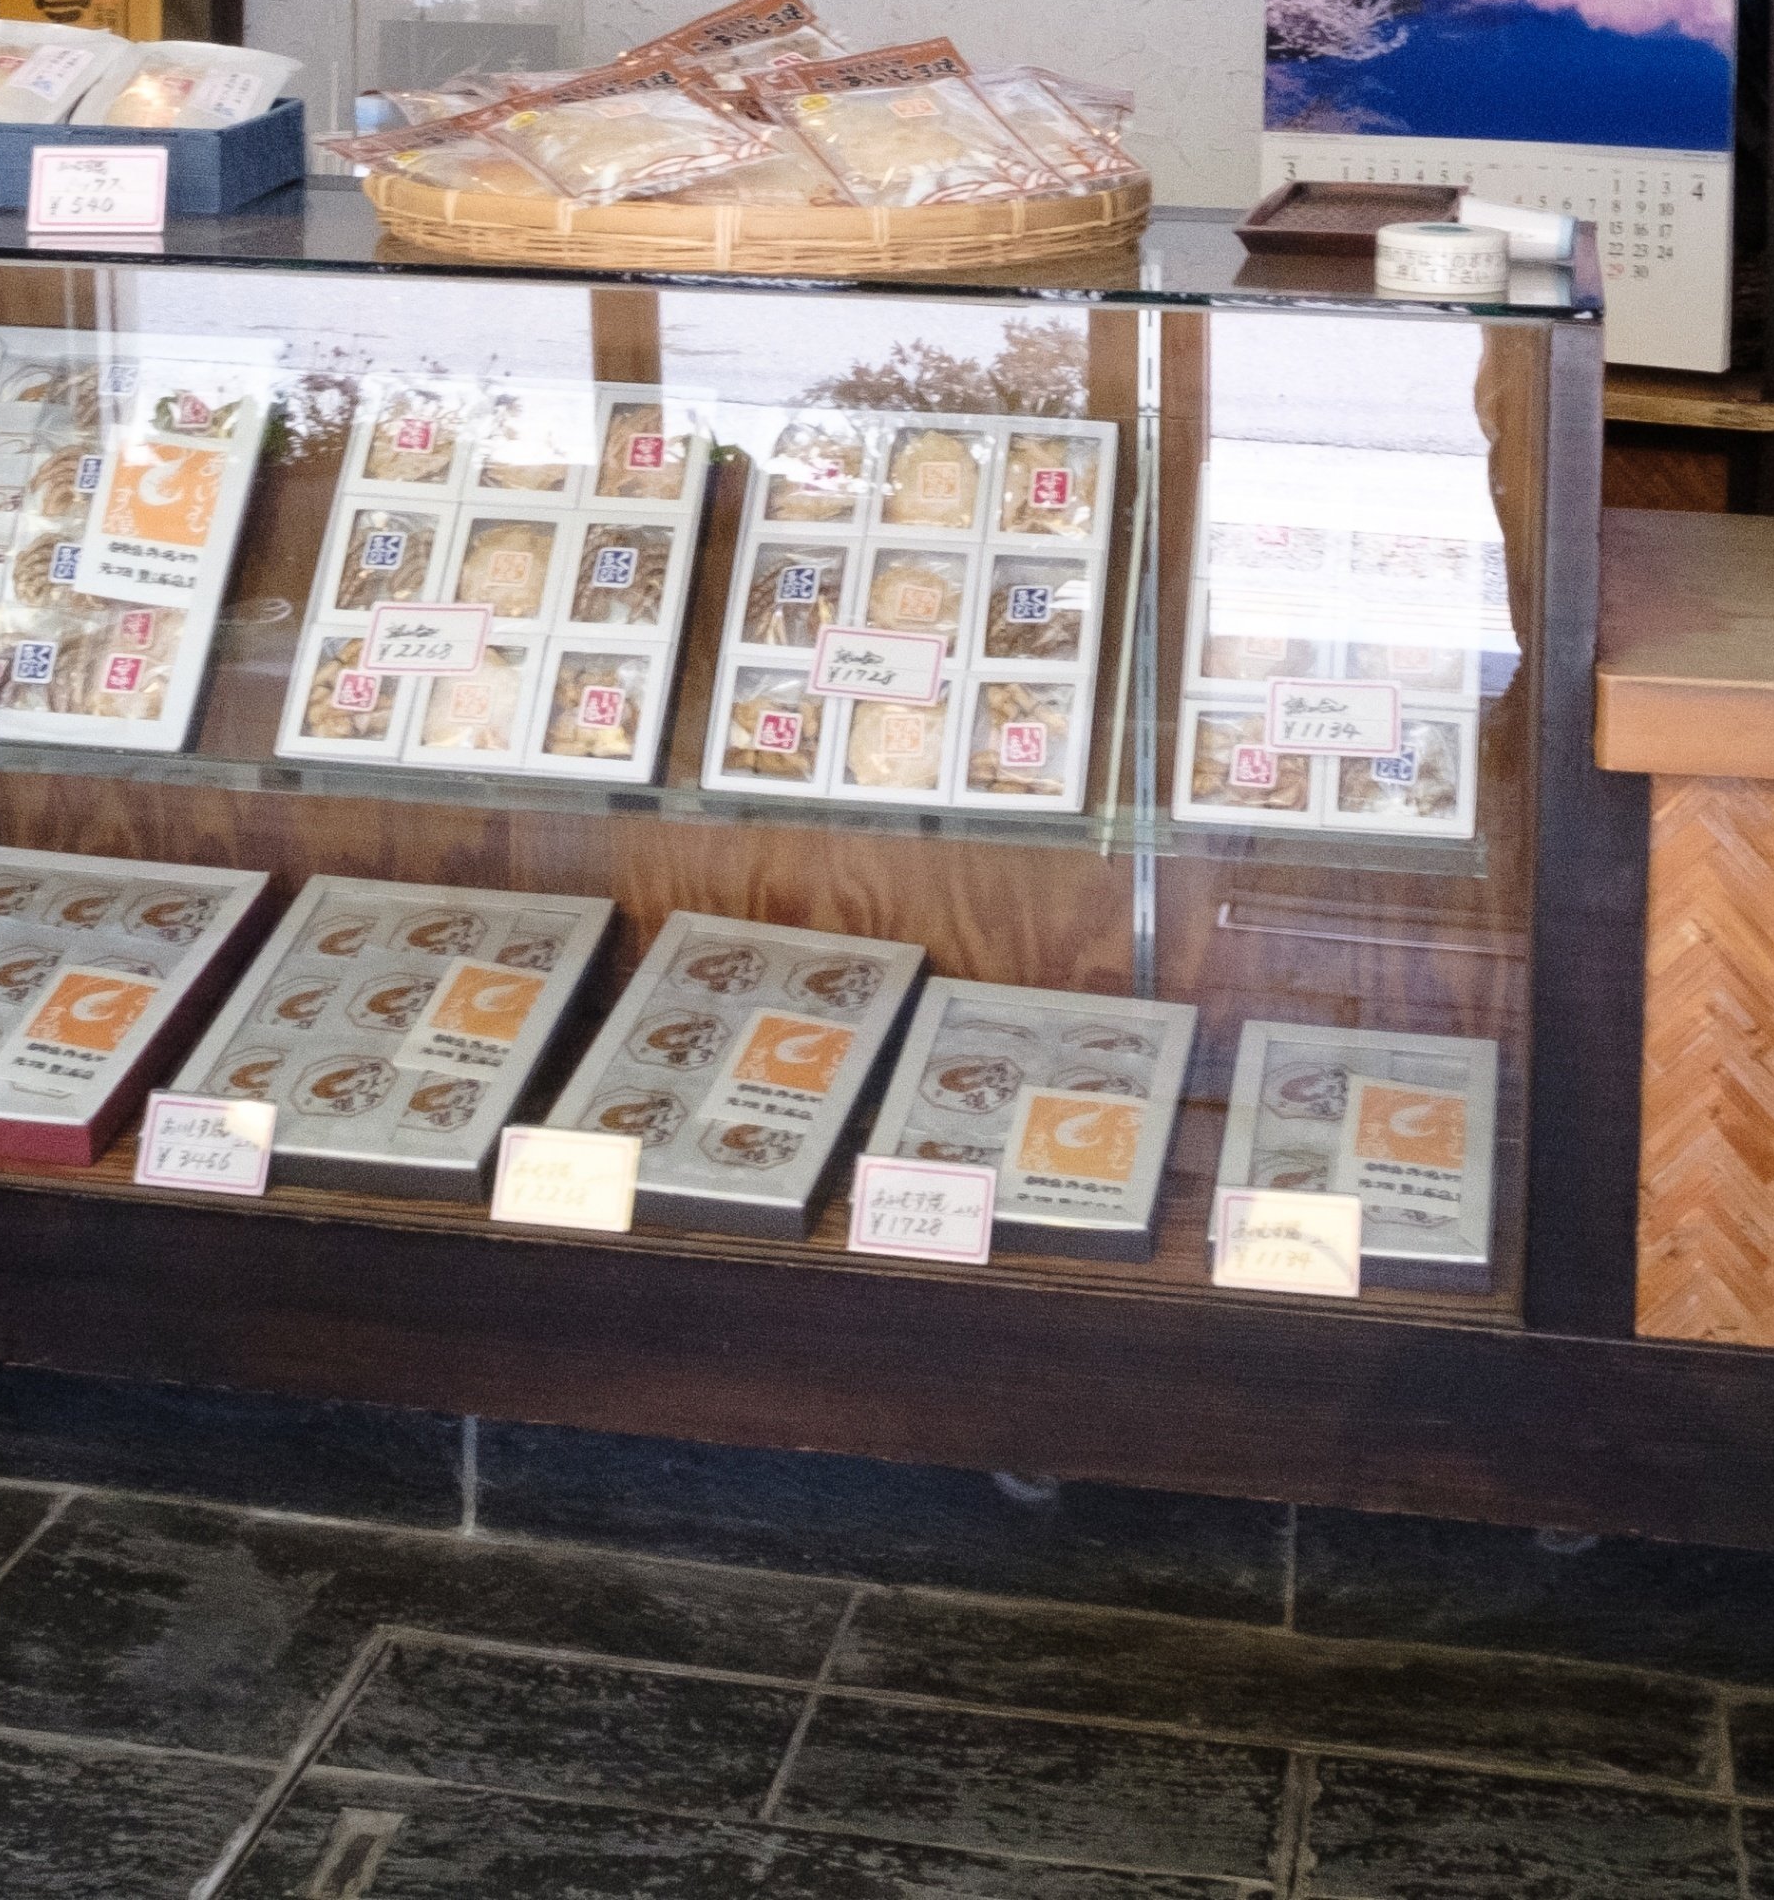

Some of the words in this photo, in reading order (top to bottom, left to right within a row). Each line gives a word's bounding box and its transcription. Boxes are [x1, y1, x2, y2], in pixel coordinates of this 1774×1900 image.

[1637, 180, 1647, 194] 2
[1663, 180, 1671, 195] 3
[1692, 182, 1705, 201] 4
[1611, 201, 1621, 215] 8
[1636, 202, 1647, 215] 9
[1658, 202, 1675, 217] 10
[1633, 222, 1649, 237] 16
[1658, 223, 1673, 238] 17
[1608, 242, 1624, 257] 22
[1632, 243, 1649, 258] 23
[1657, 244, 1674, 259] 24
[827, 665, 897, 686] ¥1728
[1283, 720, 1362, 740] ¥1134
[870, 1211, 946, 1237] ¥1728
